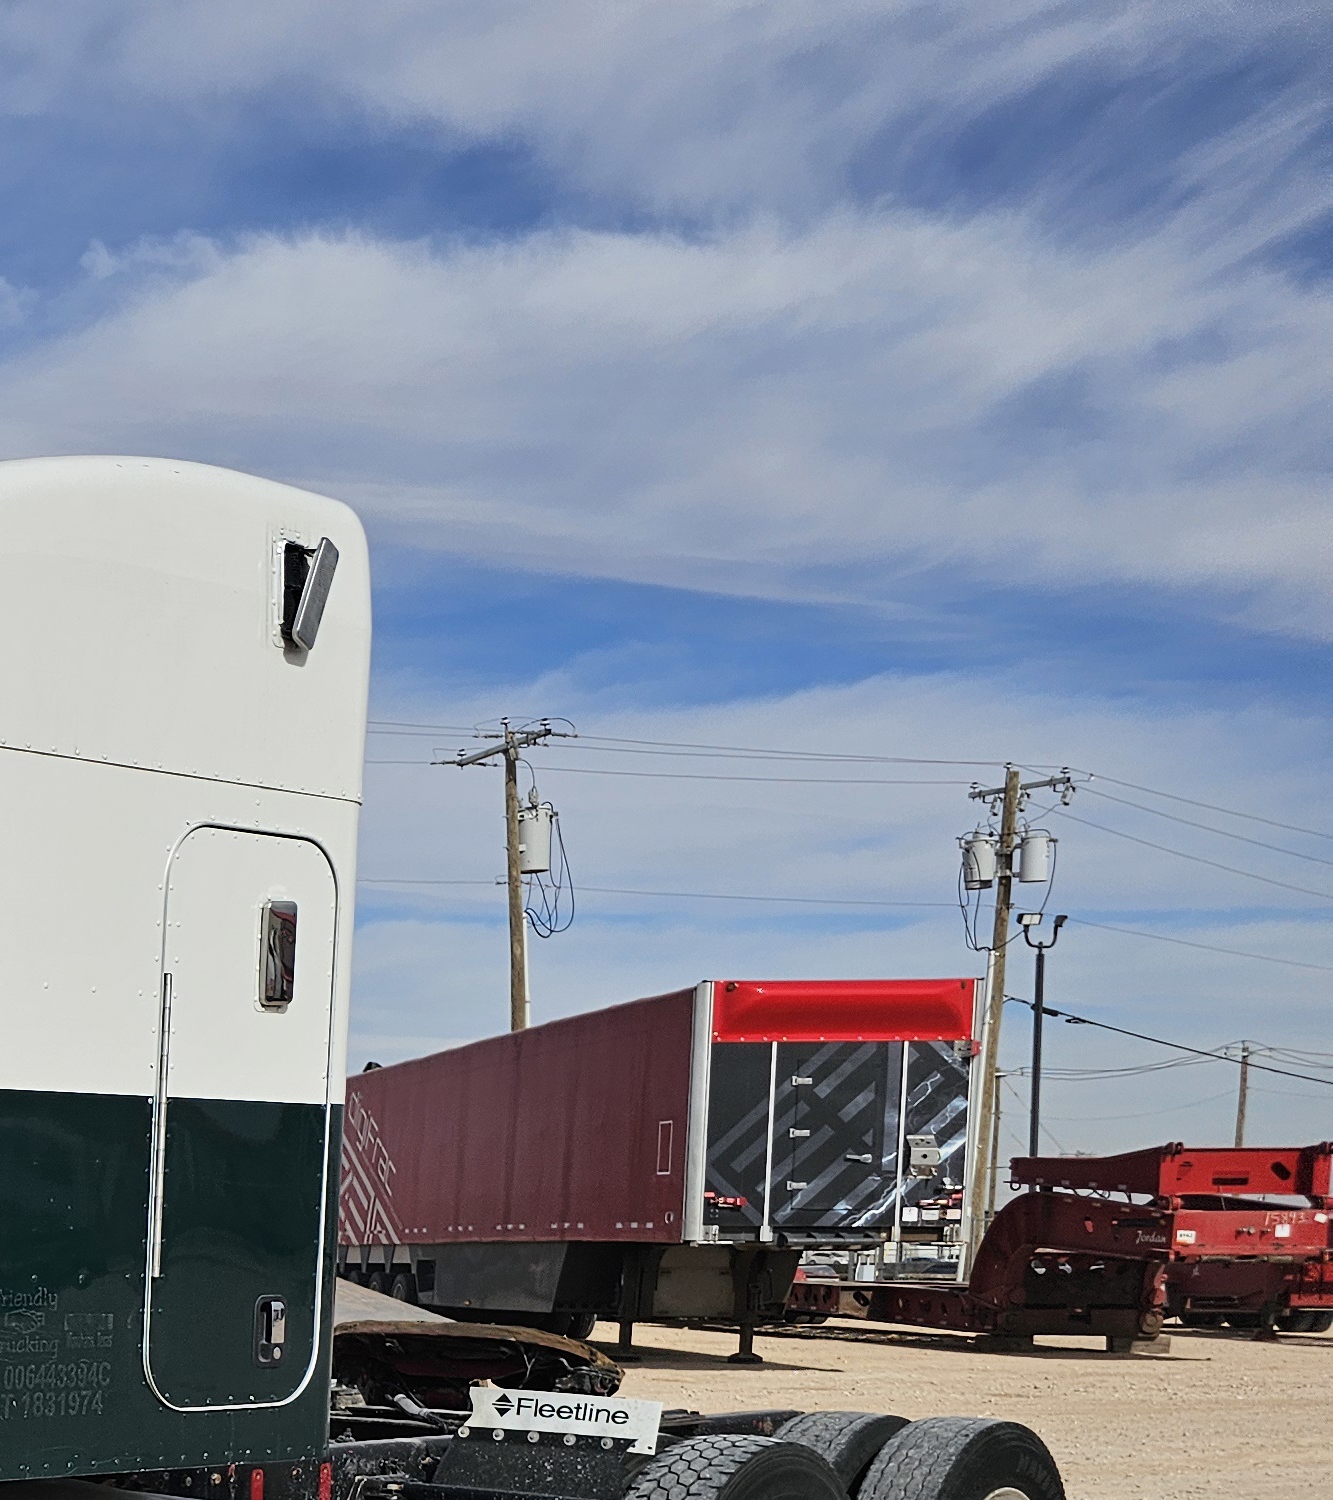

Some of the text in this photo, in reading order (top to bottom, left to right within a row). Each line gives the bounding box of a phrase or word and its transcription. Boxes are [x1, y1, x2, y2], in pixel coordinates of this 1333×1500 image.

[1135, 1230, 1167, 1244] Jordan
[22, 1389, 104, 1418] 1831974
[515, 1397, 630, 1425] Fleetline
